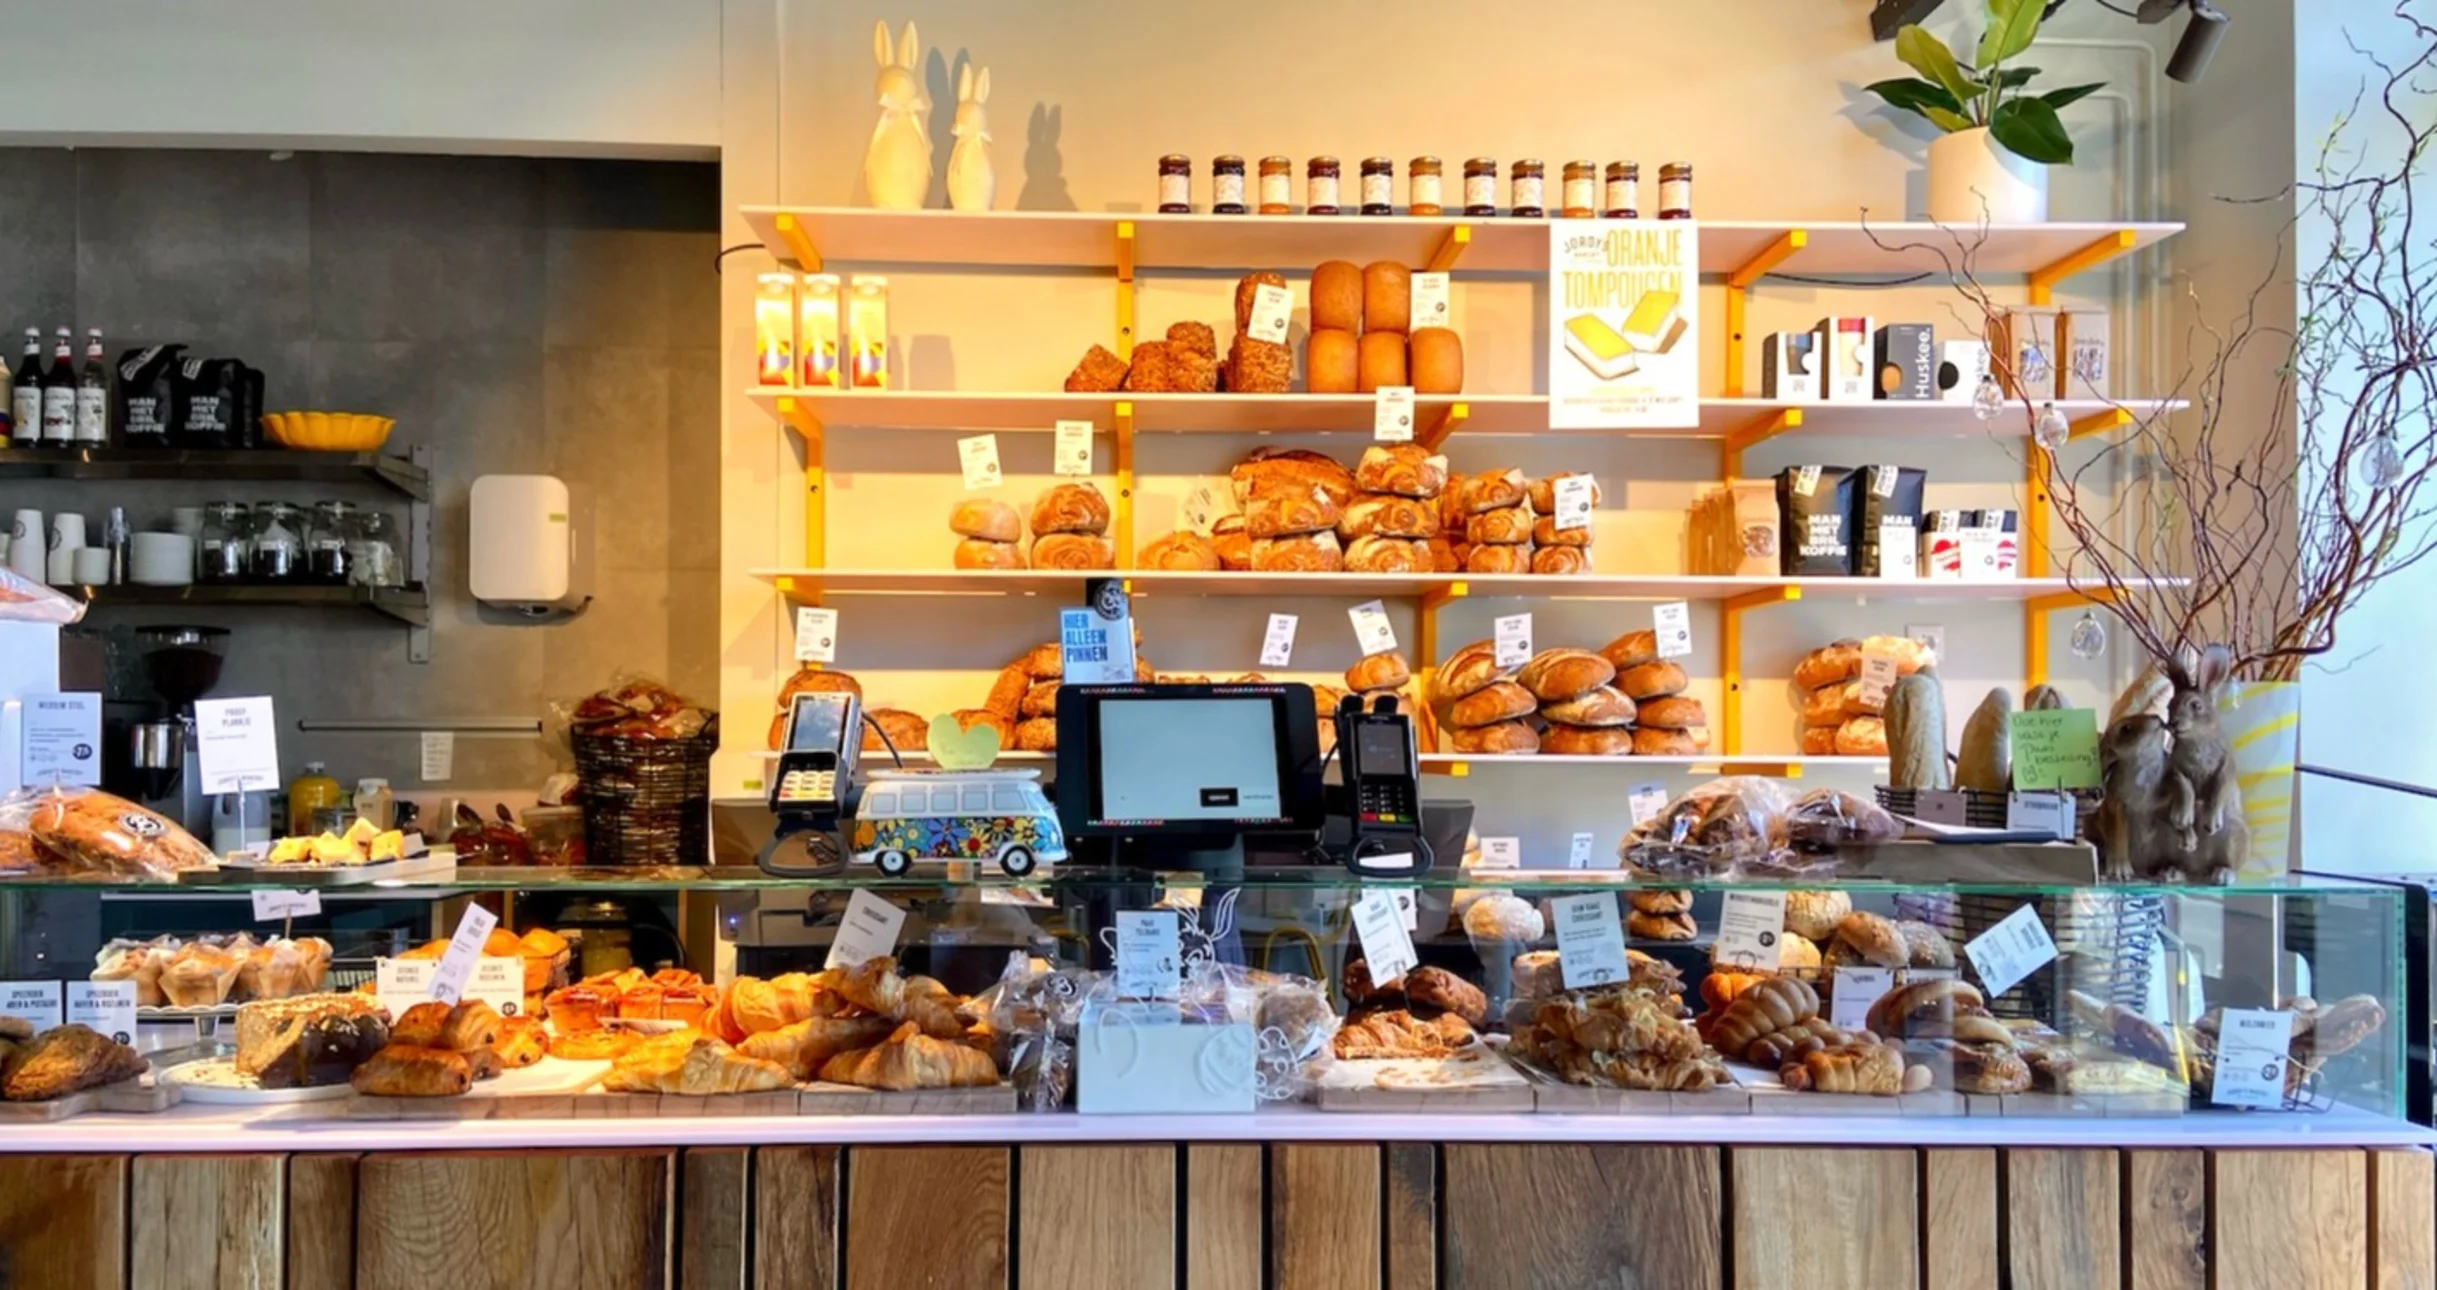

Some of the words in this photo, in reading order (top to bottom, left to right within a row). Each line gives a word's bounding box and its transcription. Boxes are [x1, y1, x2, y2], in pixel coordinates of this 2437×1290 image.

[1605, 228, 1683, 267] ORANJE
[1914, 327, 1932, 398] Huskee.
[1808, 514, 1842, 525] MAN
[1882, 515, 1913, 526] MAN
[1810, 525, 1840, 536] MET
[1809, 535, 1839, 545] BRIL
[1801, 545, 1848, 556] KOFFIE
[1064, 613, 1089, 628] HIER
[1065, 629, 1107, 645] ALLEEN
[1066, 646, 1108, 662] PINNEN
[2040, 716, 2063, 727] hier
